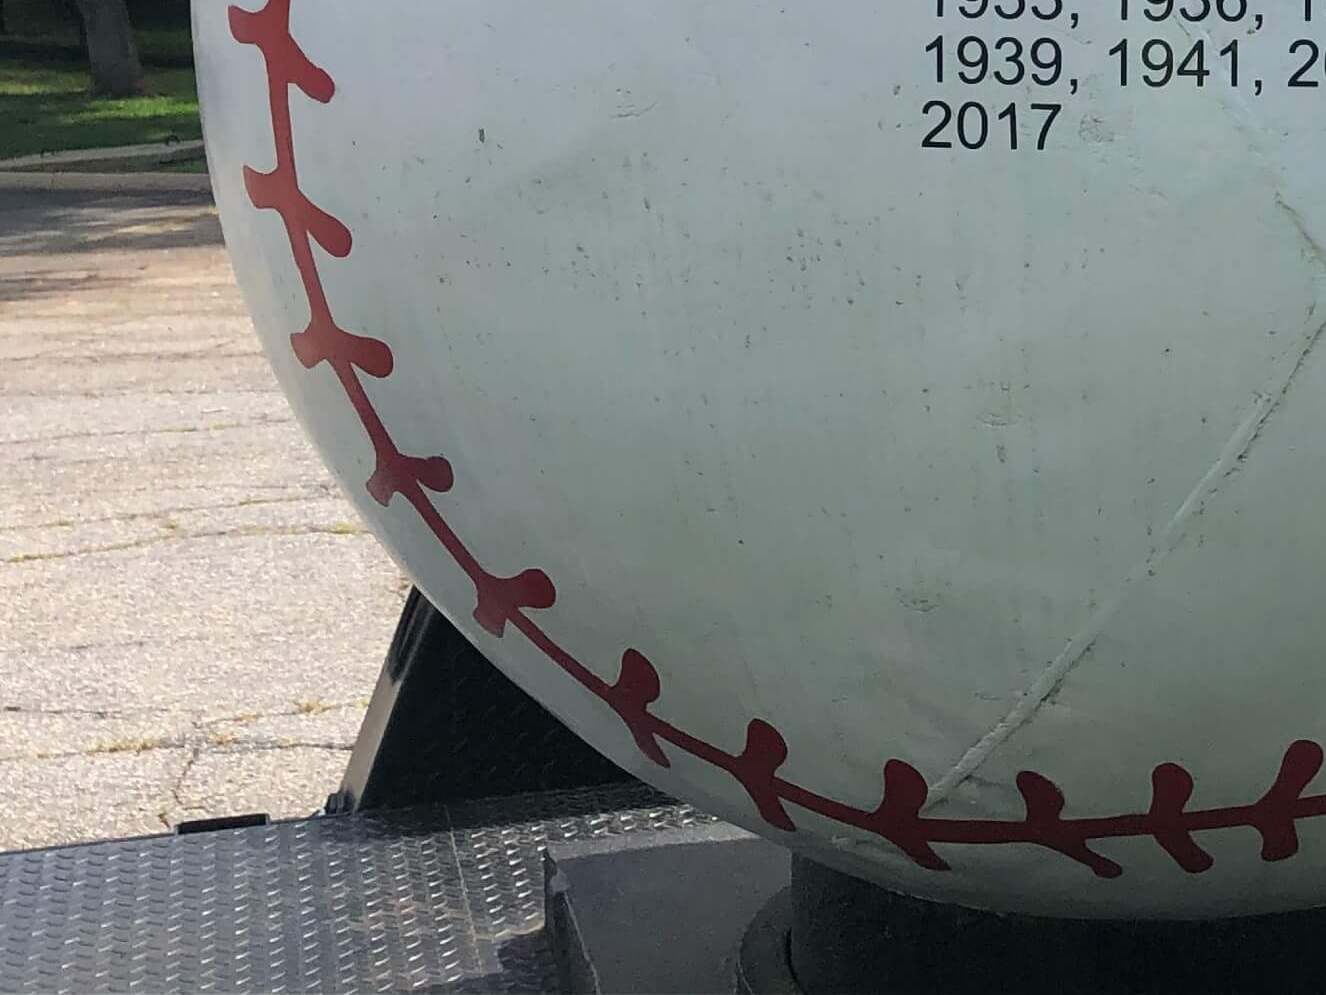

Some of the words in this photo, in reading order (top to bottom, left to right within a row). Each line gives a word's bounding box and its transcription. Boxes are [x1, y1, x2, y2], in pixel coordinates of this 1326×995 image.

[925, 34, 1079, 96] 1939,
[1108, 38, 1263, 97] 1941,
[921, 100, 1063, 151] 2017
